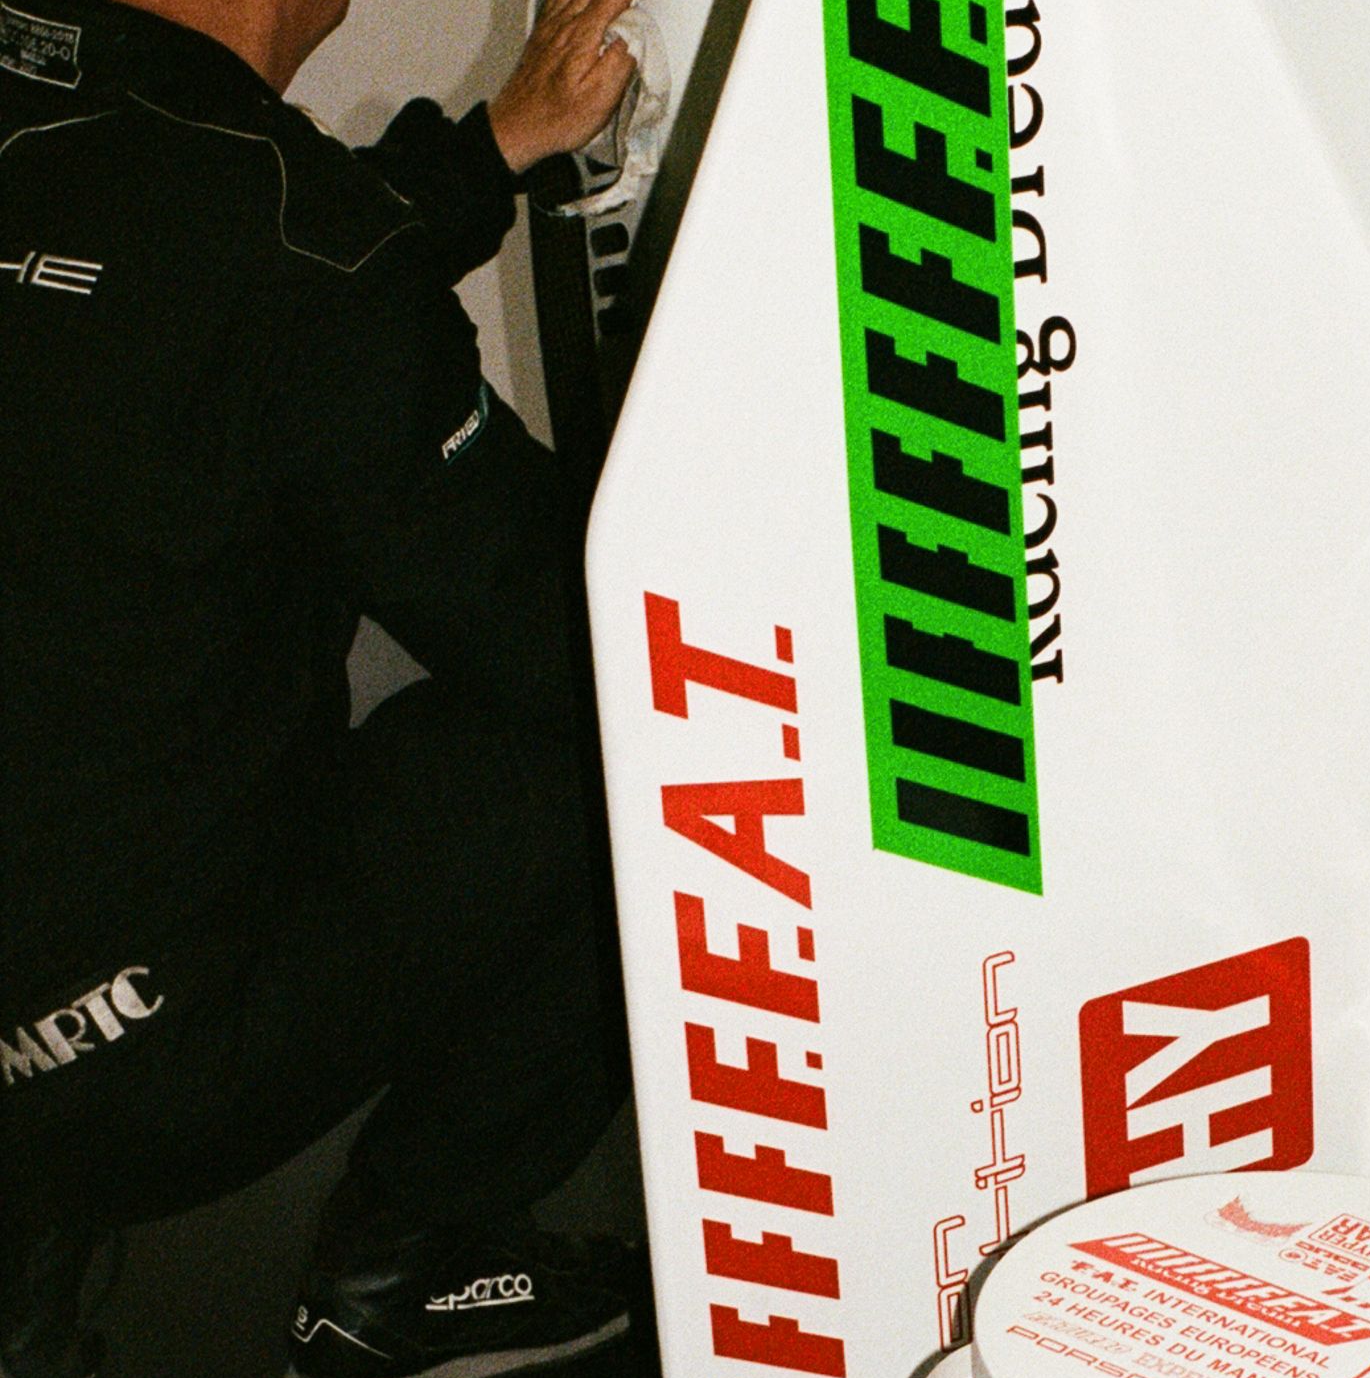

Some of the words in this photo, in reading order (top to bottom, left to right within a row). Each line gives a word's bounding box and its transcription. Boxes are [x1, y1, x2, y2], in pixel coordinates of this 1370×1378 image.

[1122, 993, 1273, 1184] HY
[1033, 1289, 1063, 1309] 24
[1065, 1302, 1166, 1348] HEURES
[1167, 1341, 1207, 1363] DU
[1039, 1270, 1178, 1330] GROUPAGES
[1142, 1287, 1333, 1370] INTERNATIONAL
